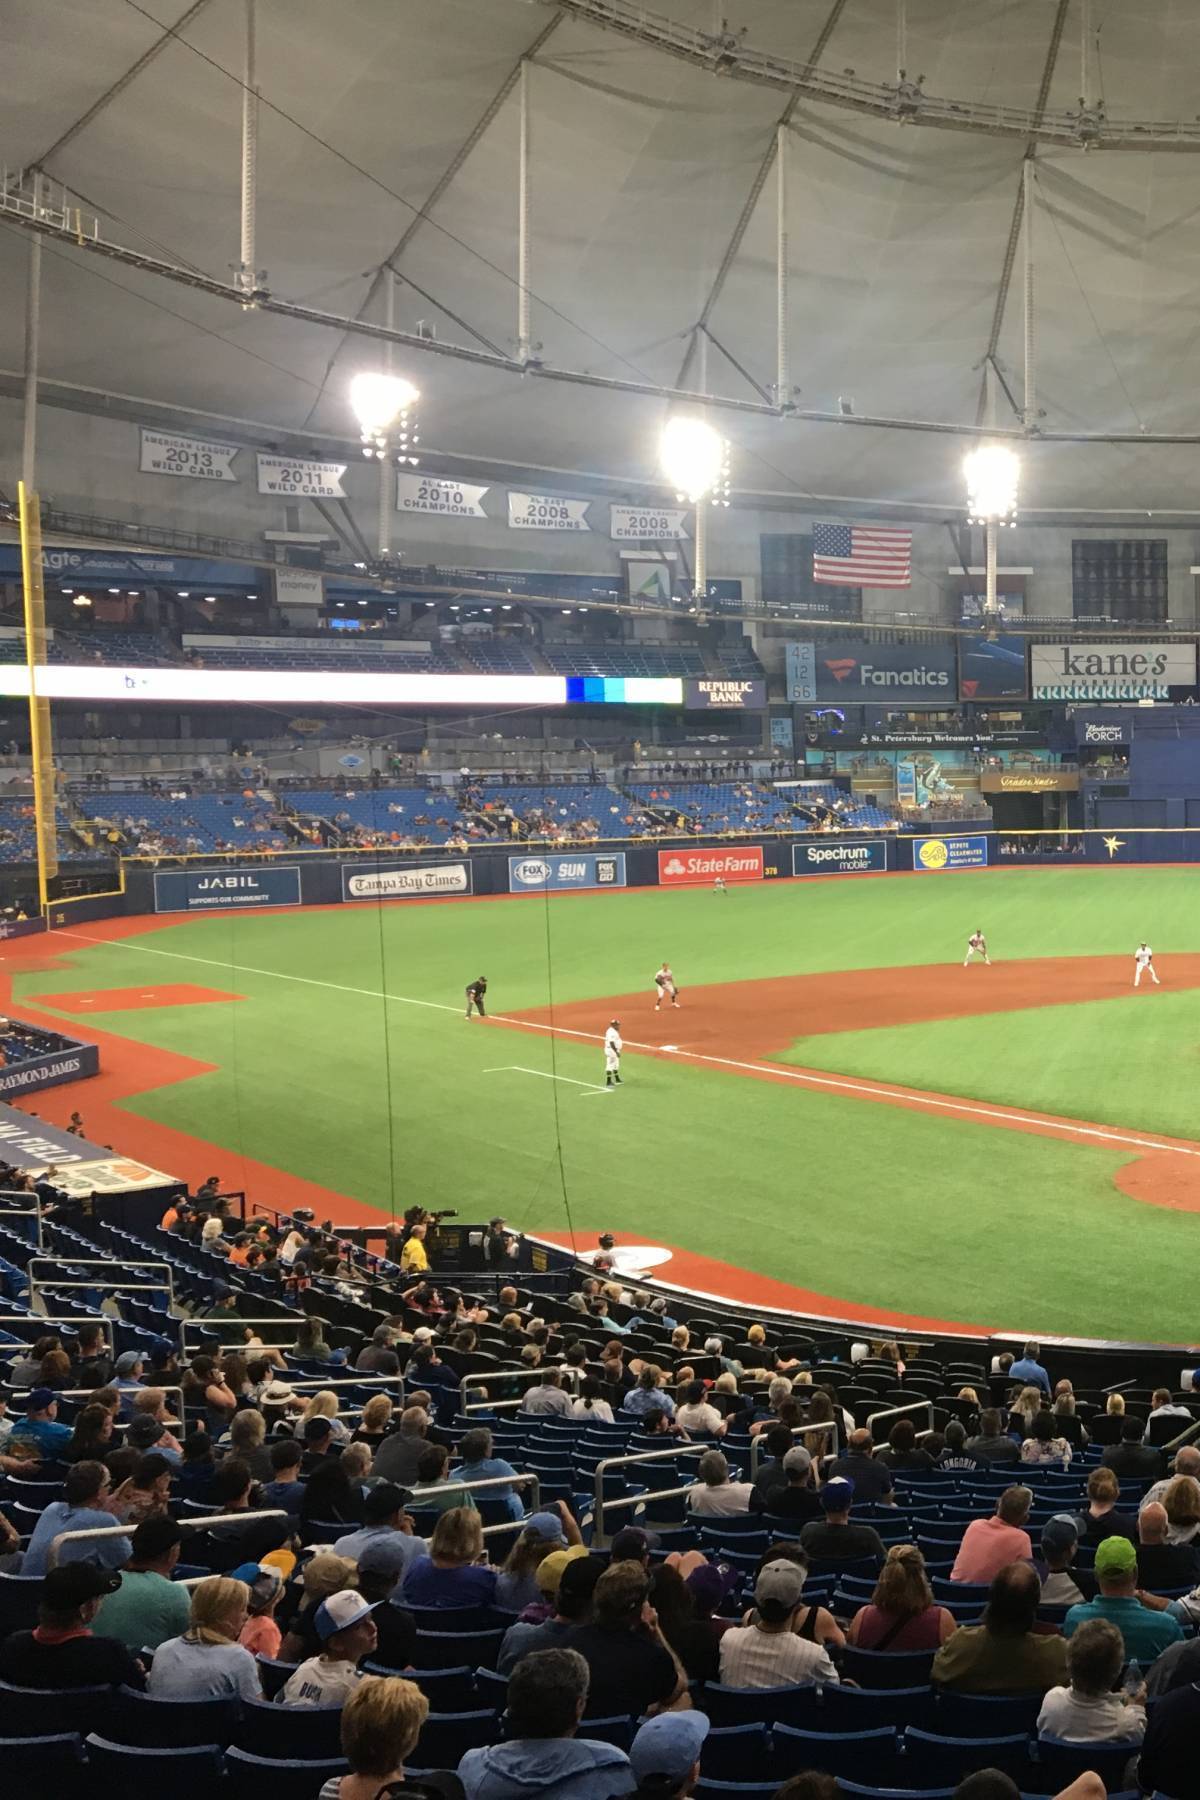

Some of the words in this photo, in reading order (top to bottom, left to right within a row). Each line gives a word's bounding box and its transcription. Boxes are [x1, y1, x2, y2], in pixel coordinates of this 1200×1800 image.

[166, 448, 213, 467] 2013
[151, 460, 183, 472] WILD
[189, 465, 223, 478] CARD
[281, 469, 323, 485] 2011
[267, 481, 298, 492] WILD
[303, 485, 334, 495] CARD
[418, 487, 463, 503] 2010
[403, 499, 475, 515] CHAMPIONS
[527, 504, 569, 518] 2008
[514, 516, 580, 529] CHAMPIONS
[628, 516, 669, 529] 2008
[616, 529, 680, 538] CHAMPIONS
[280, 581, 317, 591] money
[792, 646, 810, 660] 42
[1061, 647, 1168, 676] kane's
[795, 665, 808, 679] 12
[861, 665, 948, 686] Fanatics
[698, 681, 753, 692] REPUBLIC
[793, 685, 811, 697] 66
[710, 692, 743, 702] BANK
[885, 735, 932, 744] Petersburg
[935, 734, 974, 742] Welcomes
[975, 734, 994, 742] You!
[1086, 732, 1122, 741] PORCH
[808, 847, 868, 864] Spectrum
[523, 865, 543, 874] FOX
[558, 863, 586, 876] SUN
[840, 860, 869, 870] mobile
[198, 877, 259, 889] JABIL
[355, 878, 397, 891] Tampa
[399, 875, 423, 891] Bay
[425, 873, 461, 888] Times
[188, 897, 219, 905] SUPPORTS
[232, 894, 269, 902] COMMUNITY
[48, 1058, 80, 1077] JAMES
[6, 1137, 82, 1163] FIELD
